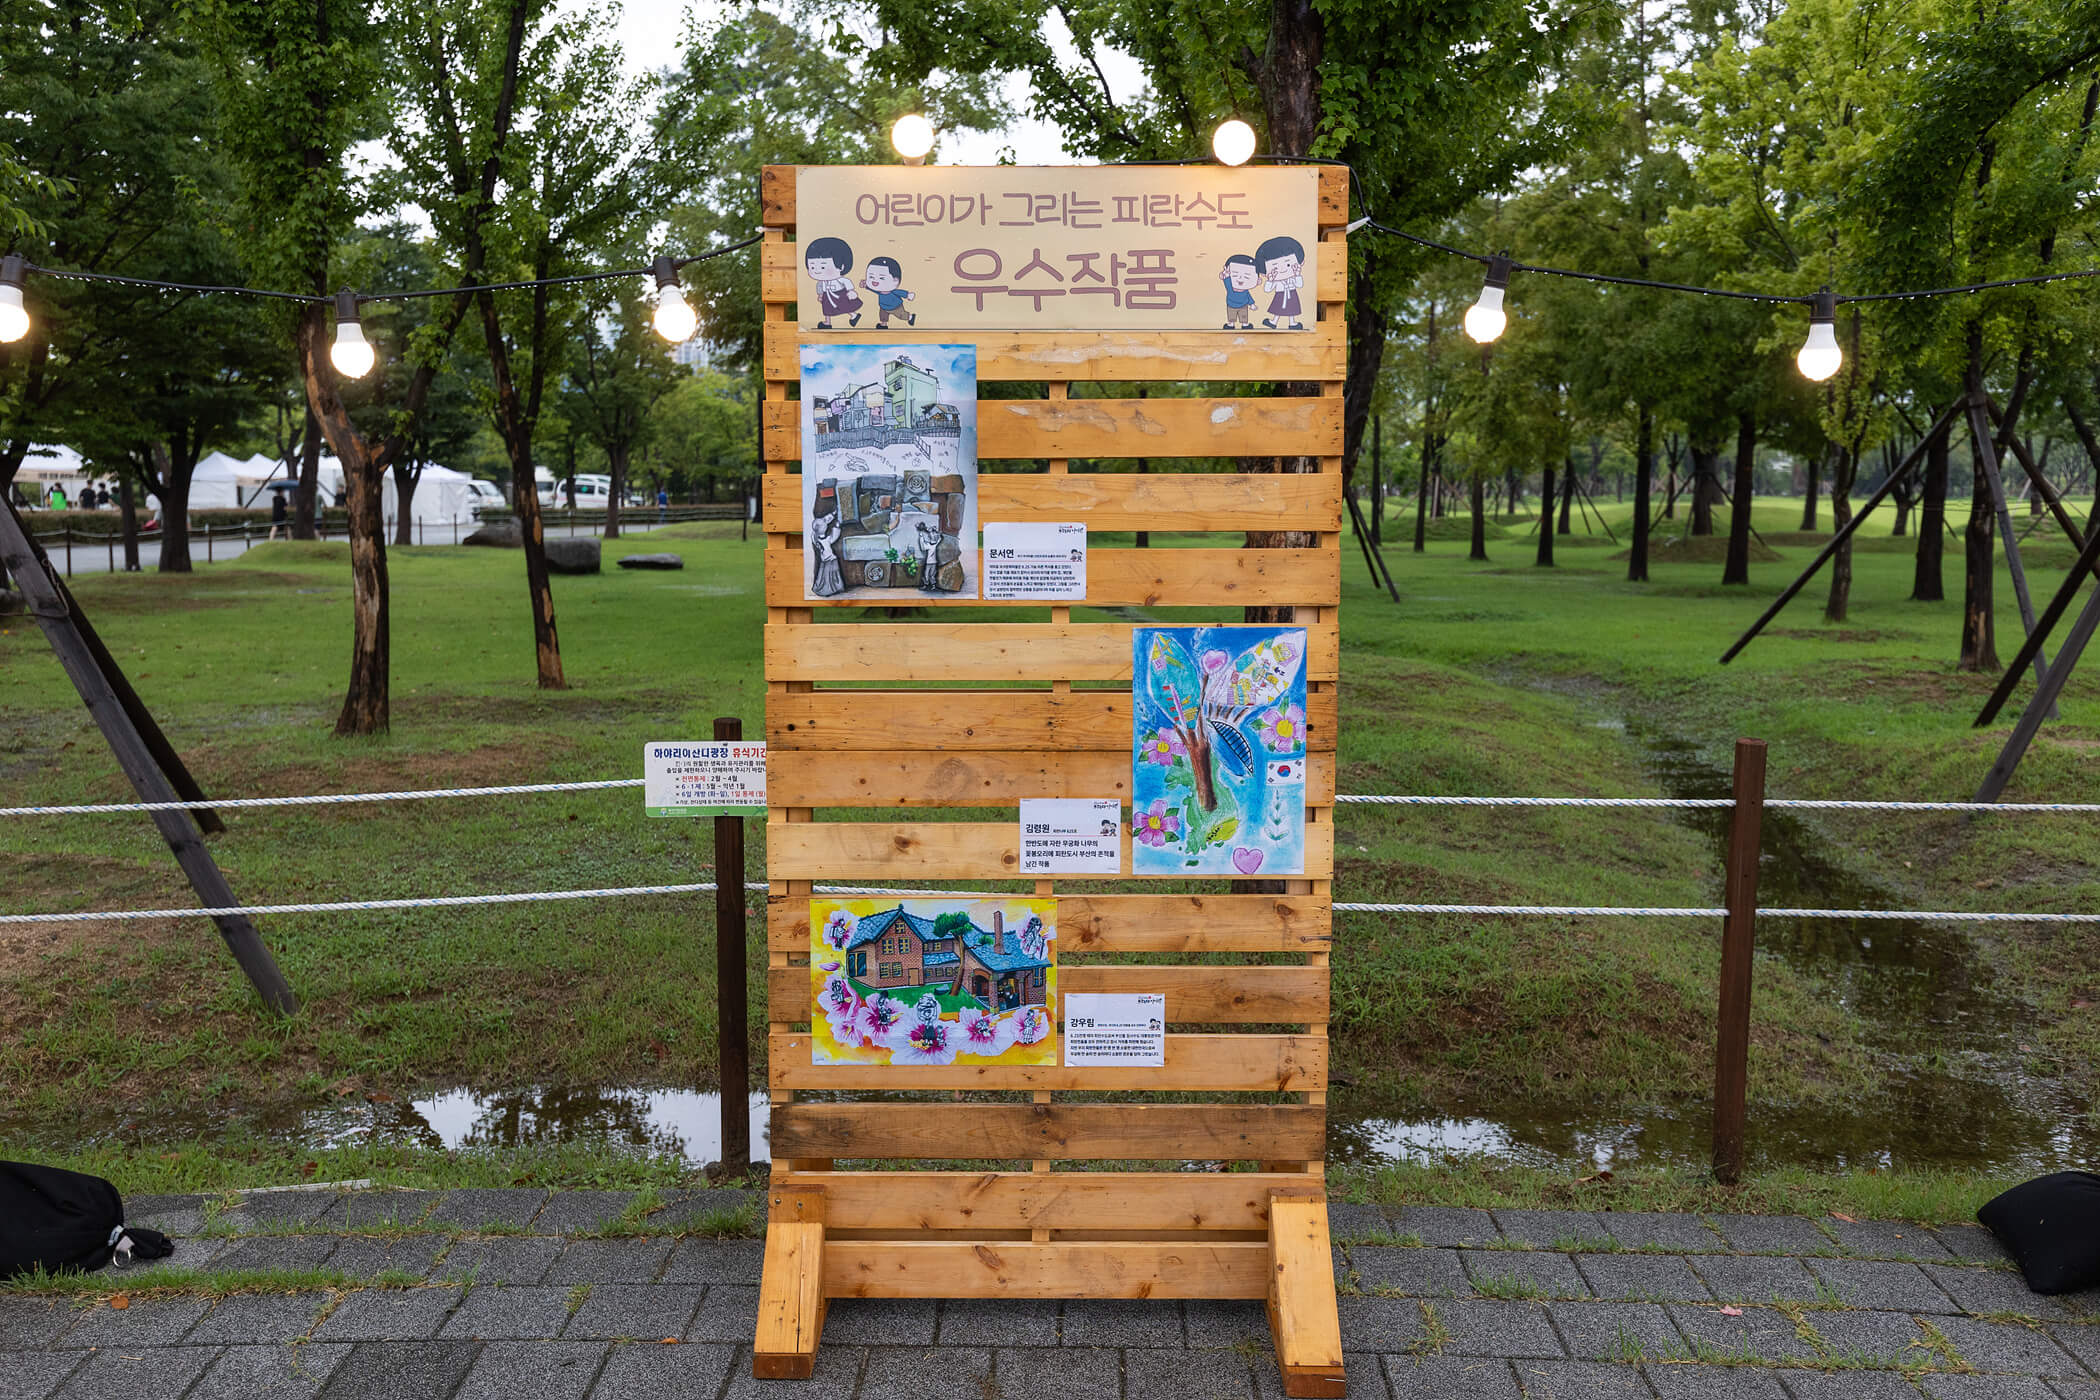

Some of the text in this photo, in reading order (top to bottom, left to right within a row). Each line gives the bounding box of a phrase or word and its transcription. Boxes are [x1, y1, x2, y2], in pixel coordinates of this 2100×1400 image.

[855, 191, 1253, 231] 어린이가 그리는 피란수도
[950, 247, 1178, 312] 우수작품
[989, 548, 1014, 559] 문서연
[1070, 1018, 1095, 1028] 강우림
